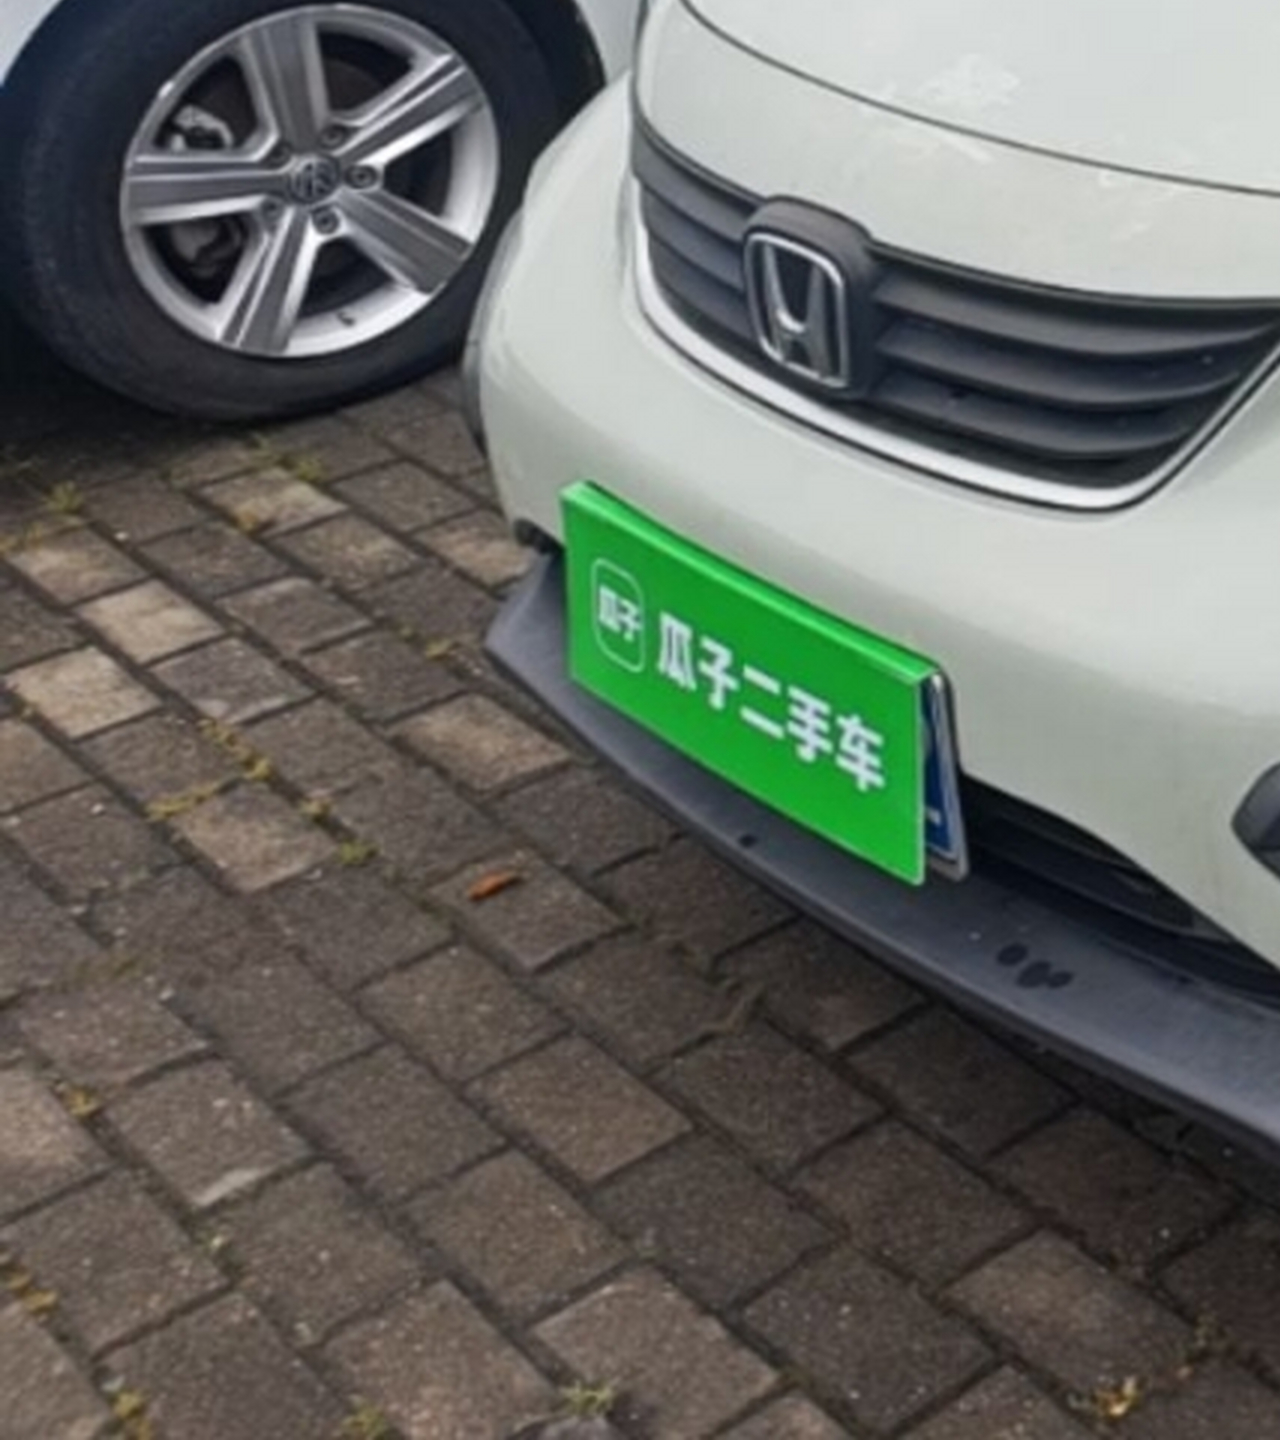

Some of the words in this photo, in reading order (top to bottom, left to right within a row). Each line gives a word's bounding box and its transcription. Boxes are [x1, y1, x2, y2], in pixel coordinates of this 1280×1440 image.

[657, 609, 885, 793] 瓜子二手车
